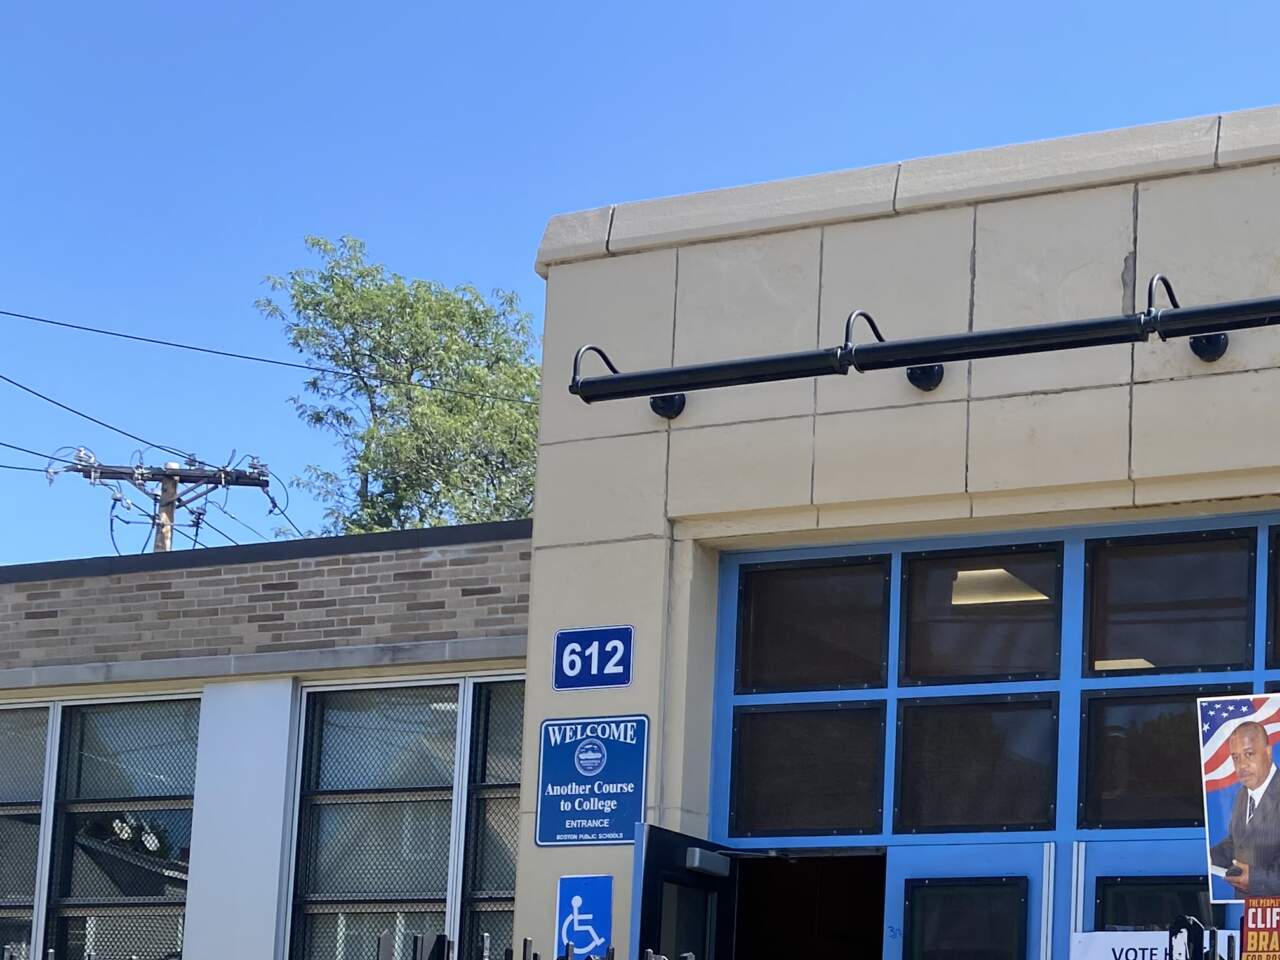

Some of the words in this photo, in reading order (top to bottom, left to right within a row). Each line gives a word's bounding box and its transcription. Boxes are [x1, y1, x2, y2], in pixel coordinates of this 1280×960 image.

[561, 639, 625, 677] 612
[547, 722, 638, 748] WELCOME
[544, 782, 592, 796] Another
[593, 780, 635, 794] Course
[559, 799, 572, 812] to
[574, 797, 618, 813] College
[565, 819, 610, 829] ENTRANCE
